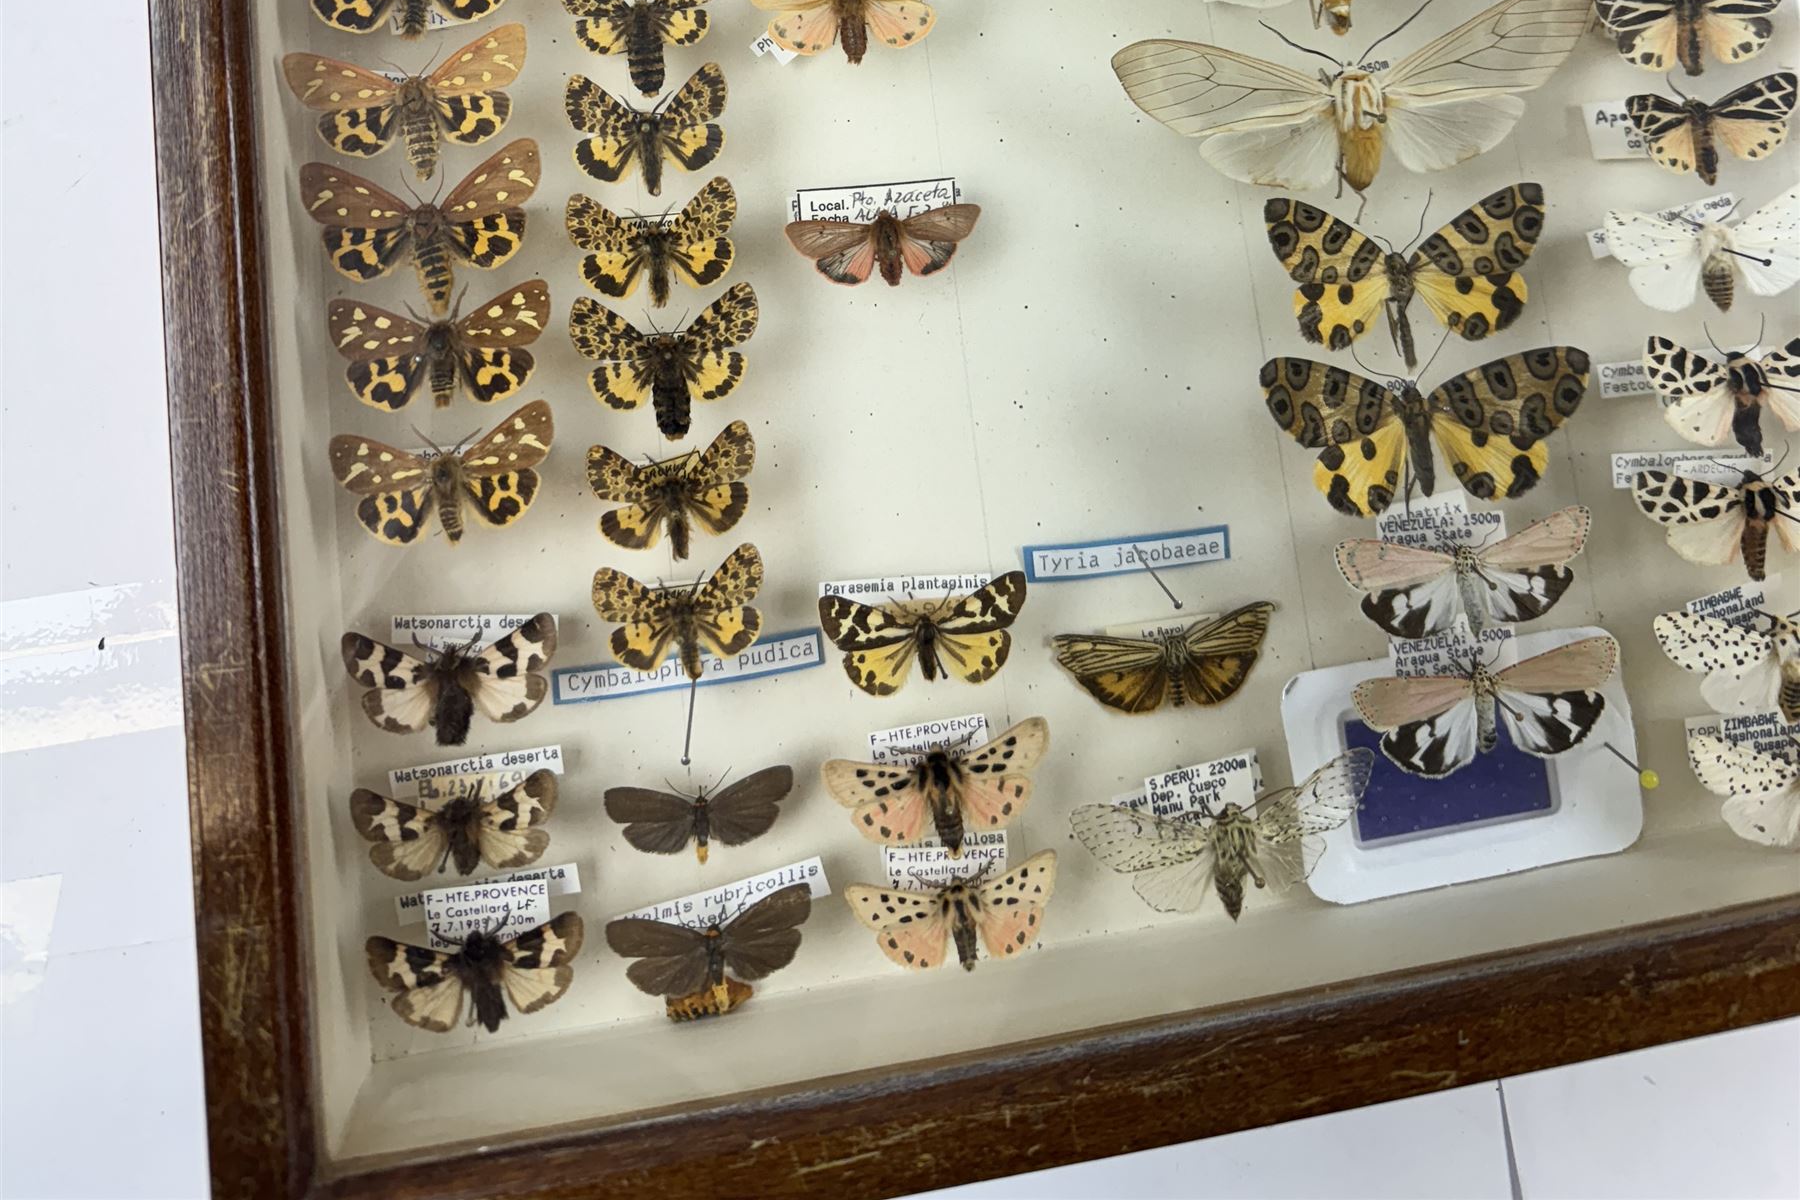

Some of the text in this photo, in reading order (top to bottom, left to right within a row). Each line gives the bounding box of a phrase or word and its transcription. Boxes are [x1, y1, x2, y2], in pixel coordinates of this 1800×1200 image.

[810, 199, 850, 212] Local.
[1463, 511, 1501, 526] 1500m
[1039, 539, 1220, 572] Tyria jacobaeae
[824, 575, 988, 596] Parasemia plantaginis
[1690, 586, 1744, 614] ZIMBABWE
[394, 615, 492, 630] Watsonarctia
[738, 638, 815, 671] pudica
[1395, 652, 1441, 669] Aragua
[1723, 712, 1779, 732] ZIMBABWE
[394, 747, 560, 783] Watsonarctia deserta
[1208, 757, 1247, 776] 2200m
[1188, 776, 1227, 794] Cusco
[889, 866, 902, 877] Le
[704, 864, 819, 908] rubricollis
[427, 909, 441, 921] Le
[445, 901, 511, 919] Castellard
